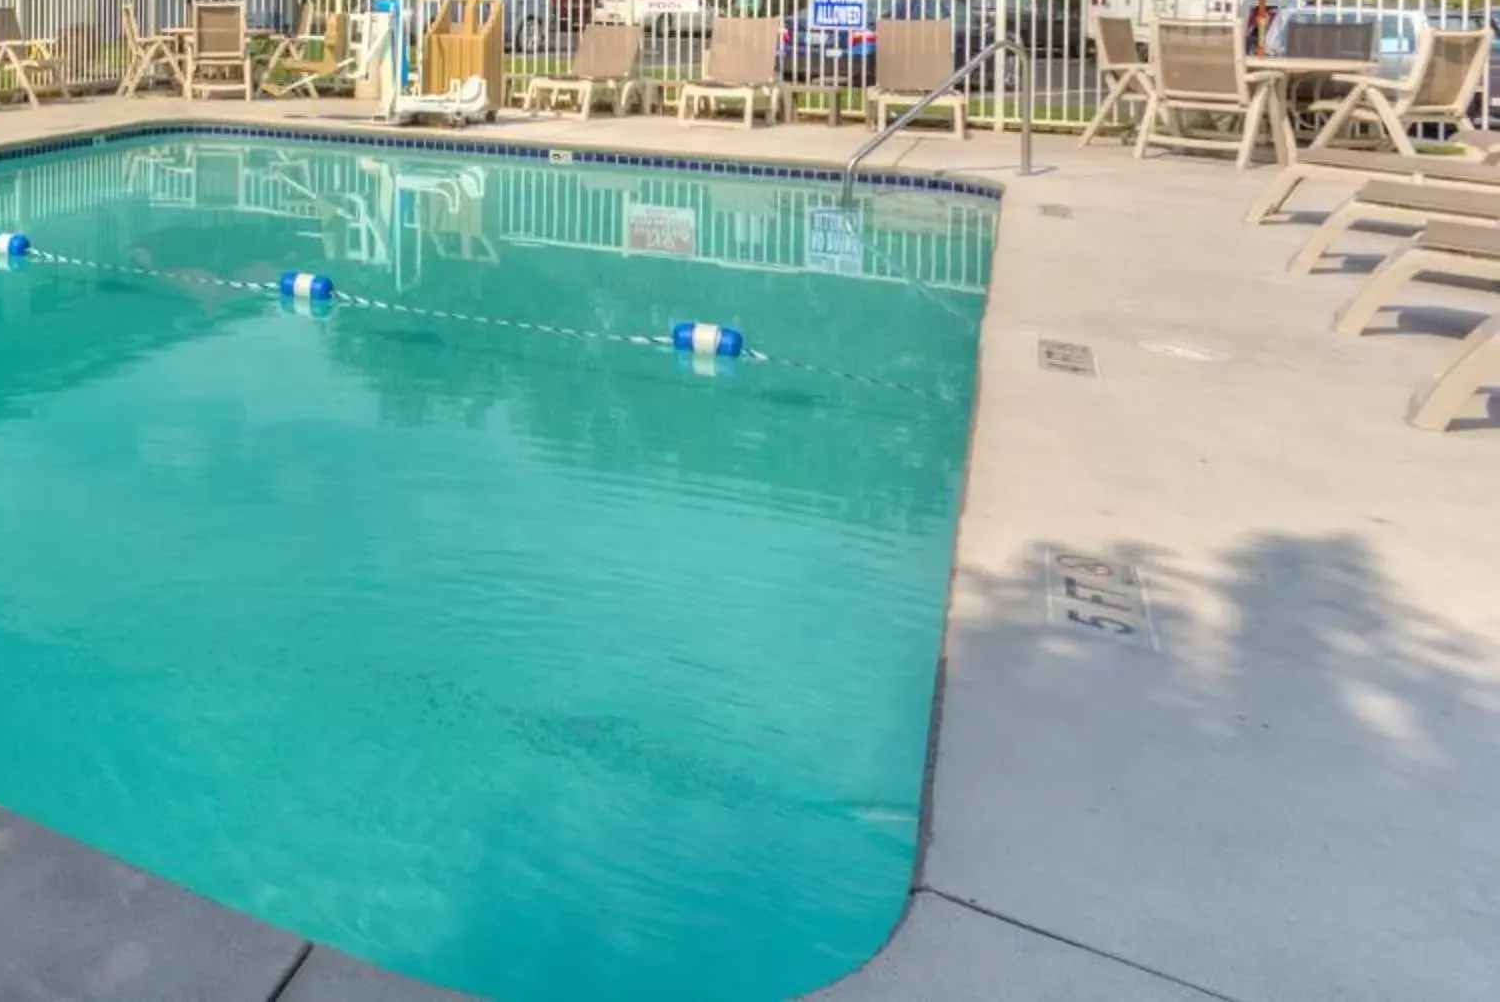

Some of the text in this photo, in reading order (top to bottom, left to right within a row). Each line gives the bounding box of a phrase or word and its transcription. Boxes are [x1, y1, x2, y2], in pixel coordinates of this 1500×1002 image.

[816, 5, 861, 24] ALLOWED
[1064, 577, 1136, 634] 5 FT
